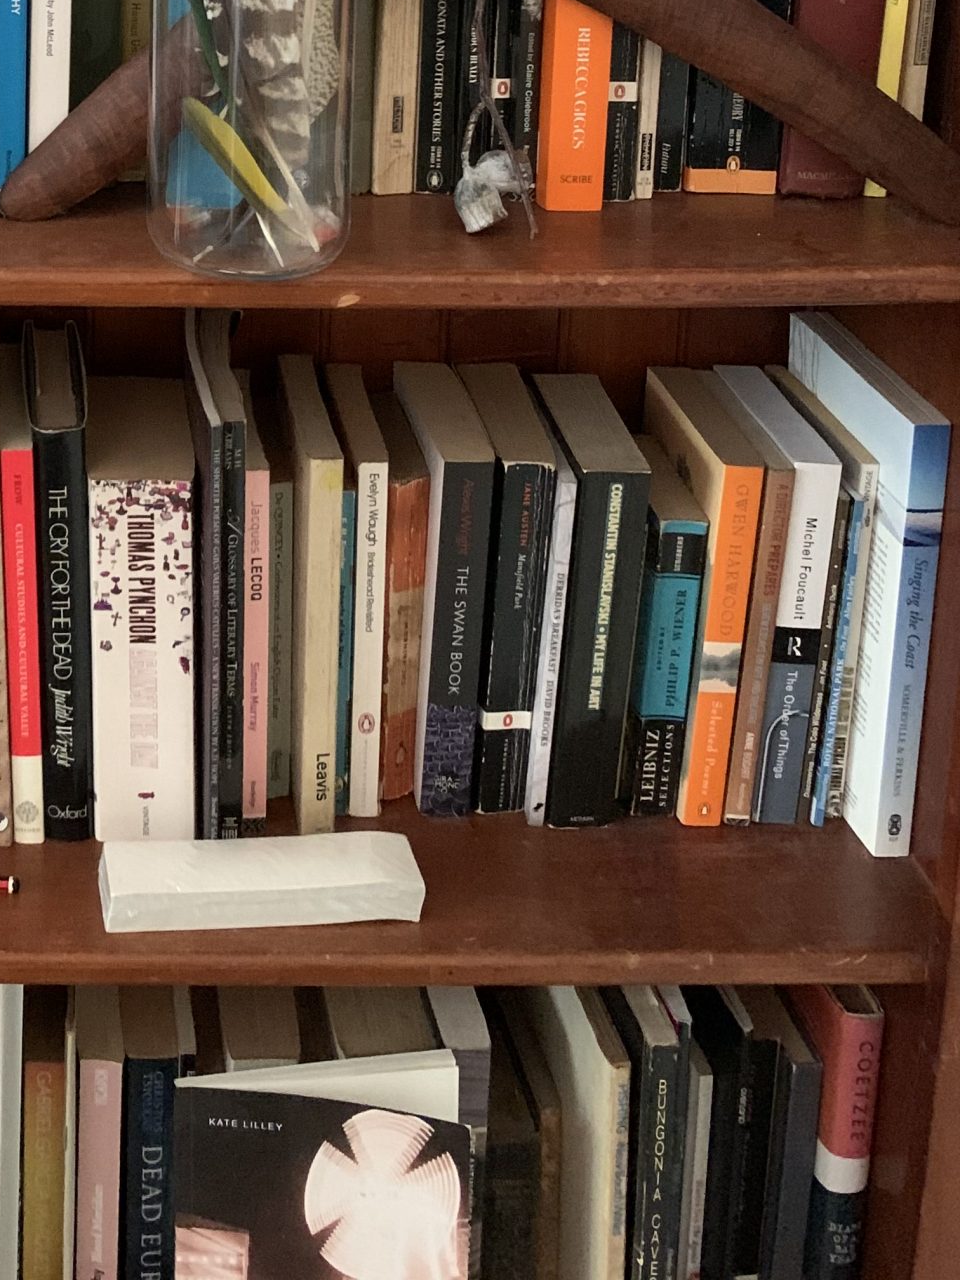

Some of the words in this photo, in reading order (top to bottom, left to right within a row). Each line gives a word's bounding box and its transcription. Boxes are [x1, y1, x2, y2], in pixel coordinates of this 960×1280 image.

[45, 0, 56, 9] by
[46, 9, 56, 28] John
[45, 28, 56, 57] McLeod
[572, 26, 592, 97] REBECCA
[570, 98, 588, 149] GIGGS
[559, 175, 594, 185] SCRIBE
[367, 472, 380, 507] Evelyn
[248, 499, 264, 554] Jacques
[365, 508, 379, 548] Waugh
[605, 482, 624, 550] CONSTANTIN
[127, 512, 156, 573] THOMAS
[801, 516, 818, 561] Michel
[249, 556, 264, 602] LECOQ
[365, 551, 377, 598] Brideshead
[596, 550, 617, 625] STANISLAVSKI
[793, 564, 813, 620] Foucault
[127, 577, 158, 645] PYNCHON
[364, 597, 376, 633] Revisited
[591, 651, 607, 674] LIFE
[595, 634, 608, 650] MY
[587, 687, 603, 711] ART
[590, 674, 604, 687] IN
[783, 669, 799, 690] The
[779, 692, 795, 726] Order
[778, 727, 791, 740] of
[316, 751, 331, 801] Leavis
[639, 729, 661, 803] LEIBNIZ
[658, 723, 675, 808] SELECTIONS
[773, 740, 791, 779] Things
[47, 805, 88, 818] Oxford
[848, 1040, 875, 1143] COETZEE
[207, 1117, 238, 1129] KATE
[241, 1120, 282, 1133] LILLEY
[652, 1079, 667, 1202] BUNGONIA
[140, 1145, 164, 1223] DEAD
